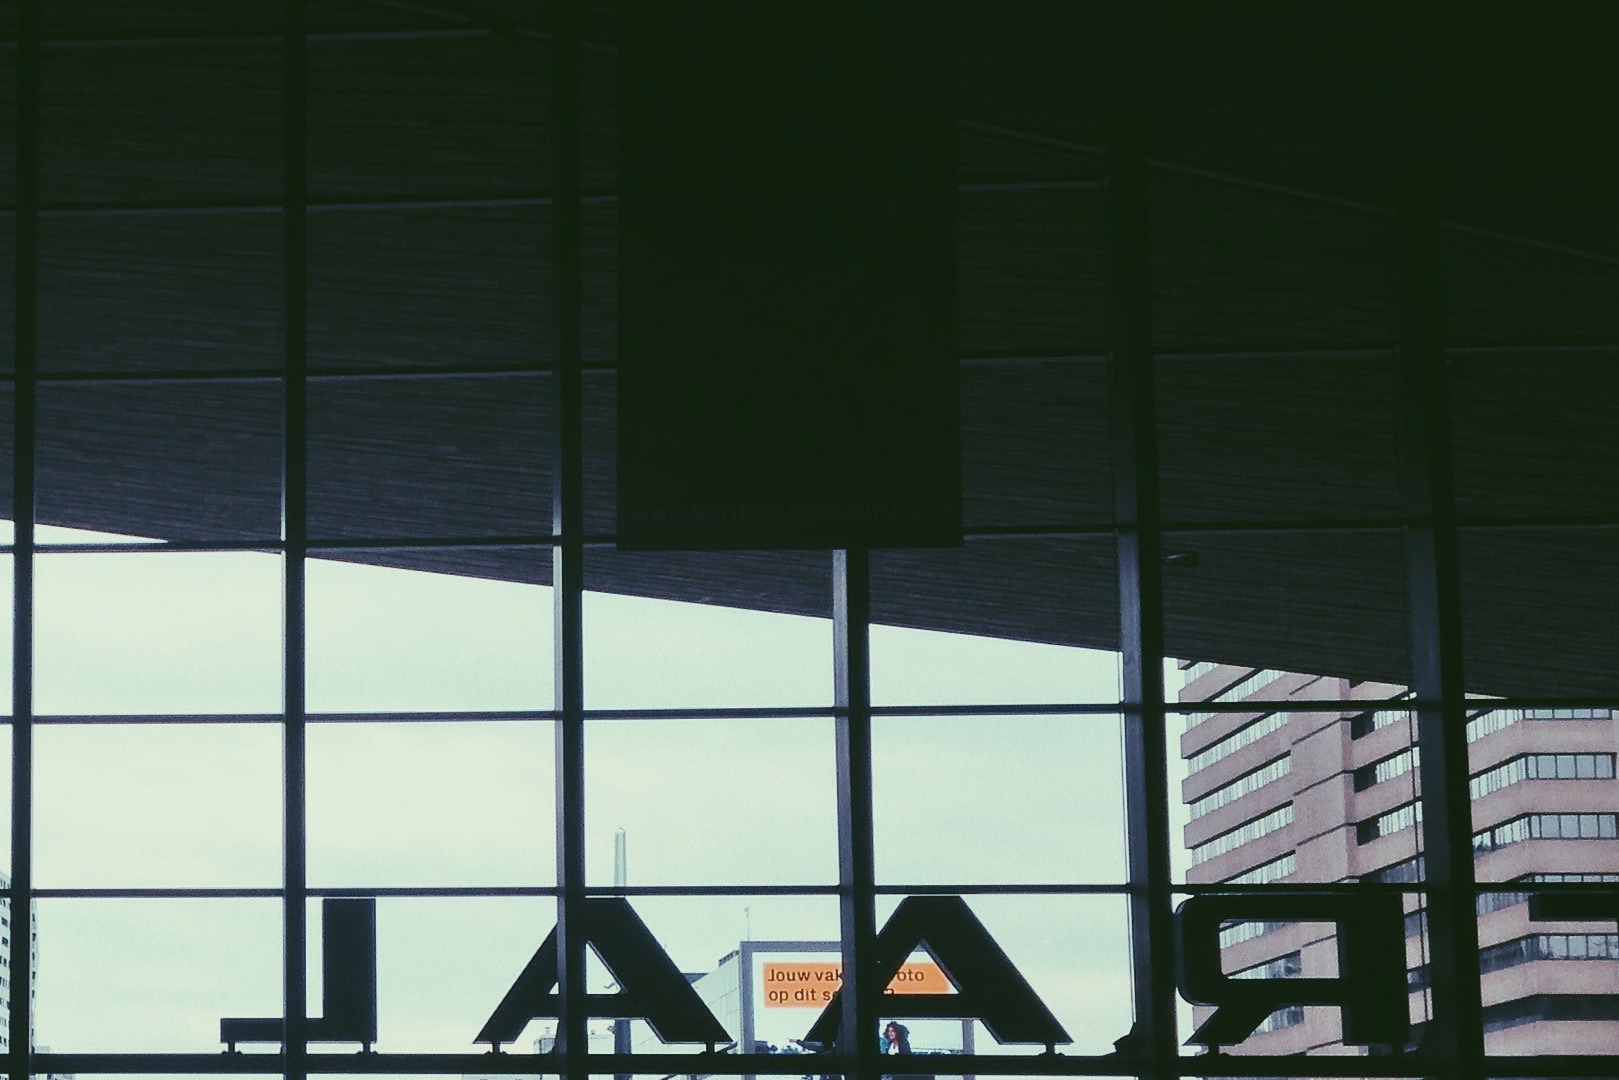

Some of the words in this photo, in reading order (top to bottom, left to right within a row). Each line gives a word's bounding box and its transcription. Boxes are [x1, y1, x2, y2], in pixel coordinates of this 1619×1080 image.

[768, 968, 811, 982] Jouw
[768, 990, 789, 1004] op
[794, 988, 817, 1001] dit
